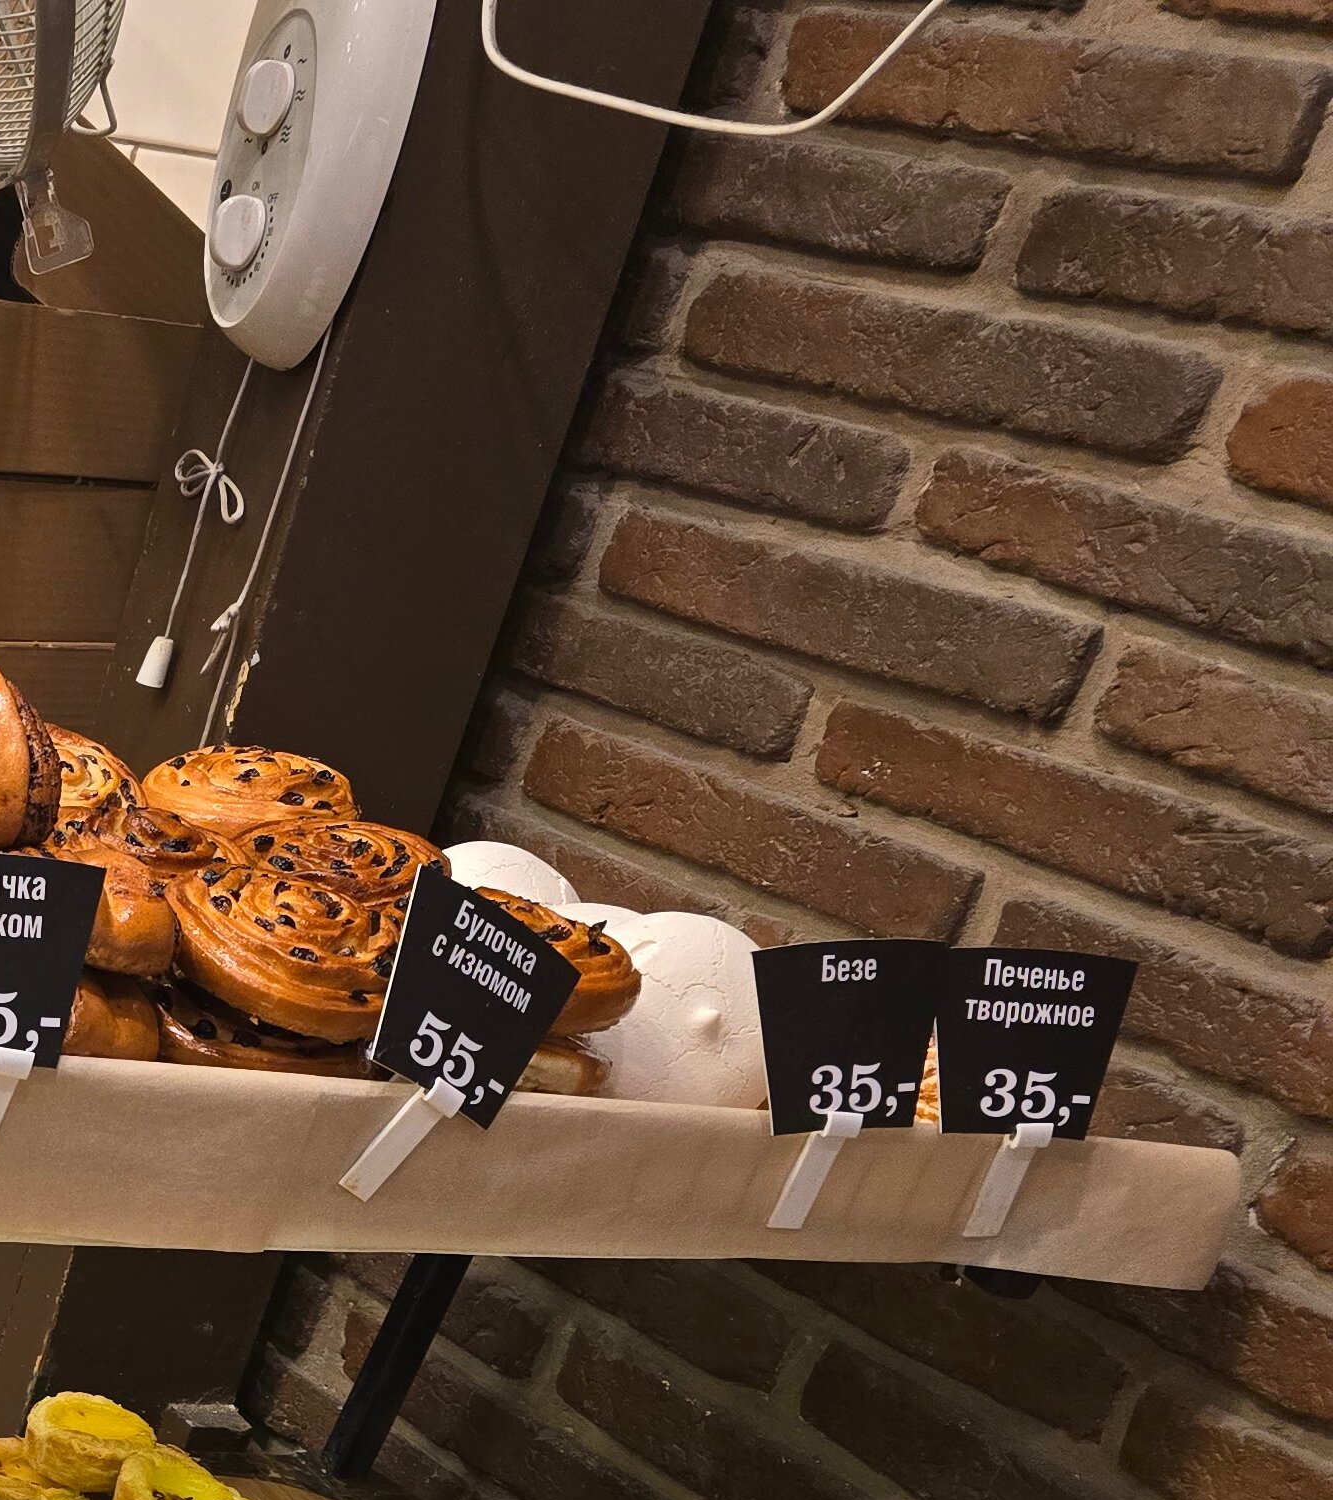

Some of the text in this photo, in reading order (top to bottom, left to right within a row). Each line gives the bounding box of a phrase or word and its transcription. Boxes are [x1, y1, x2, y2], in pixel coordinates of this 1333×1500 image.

[453, 899, 537, 975] Булочка
[432, 934, 532, 1014] с изюмом
[821, 954, 877, 982] Безе
[984, 958, 1085, 991] Печенье
[965, 998, 1095, 1028] творожное
[409, 1011, 505, 1105] 55,-
[809, 1062, 916, 1117] 35,-
[979, 1068, 1091, 1127] 35,-
